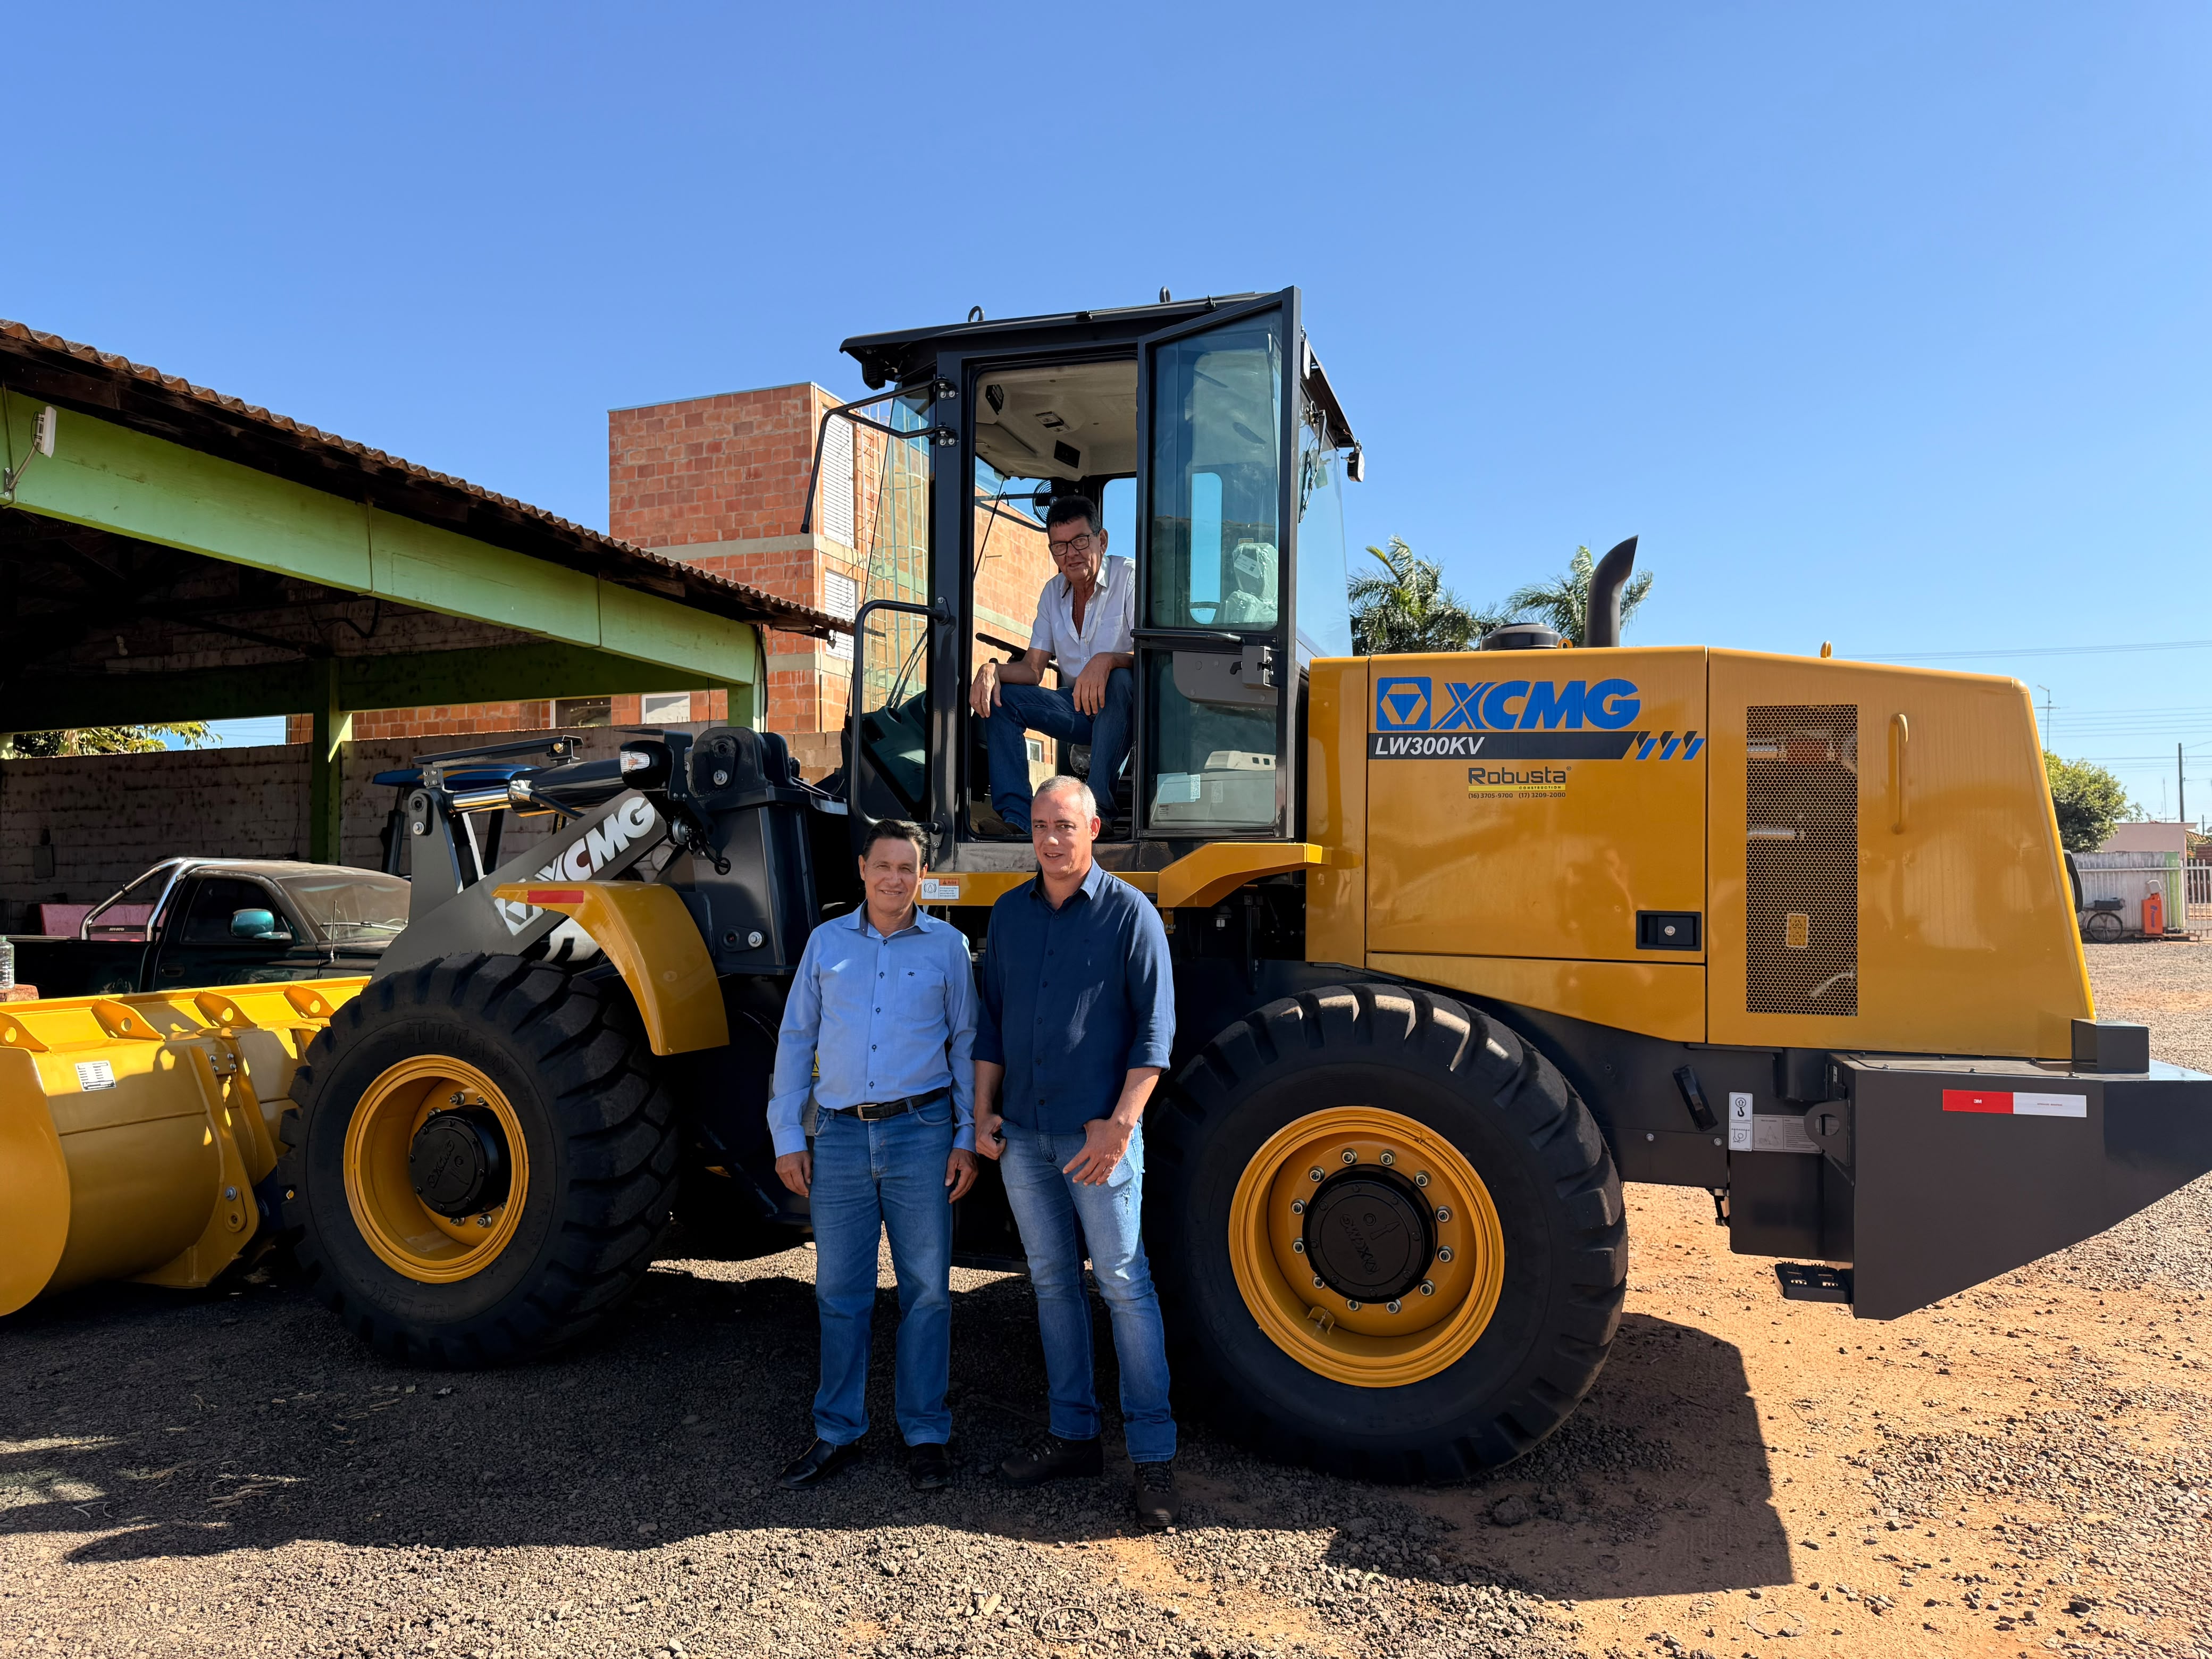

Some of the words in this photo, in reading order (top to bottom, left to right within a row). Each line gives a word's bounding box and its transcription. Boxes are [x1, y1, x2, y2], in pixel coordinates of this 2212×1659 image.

[1431, 678, 1640, 730] XCMG
[1375, 736, 1485, 755] LW300KV
[1468, 766, 1566, 784] Robusta
[406, 1019, 515, 1076] TITAN
